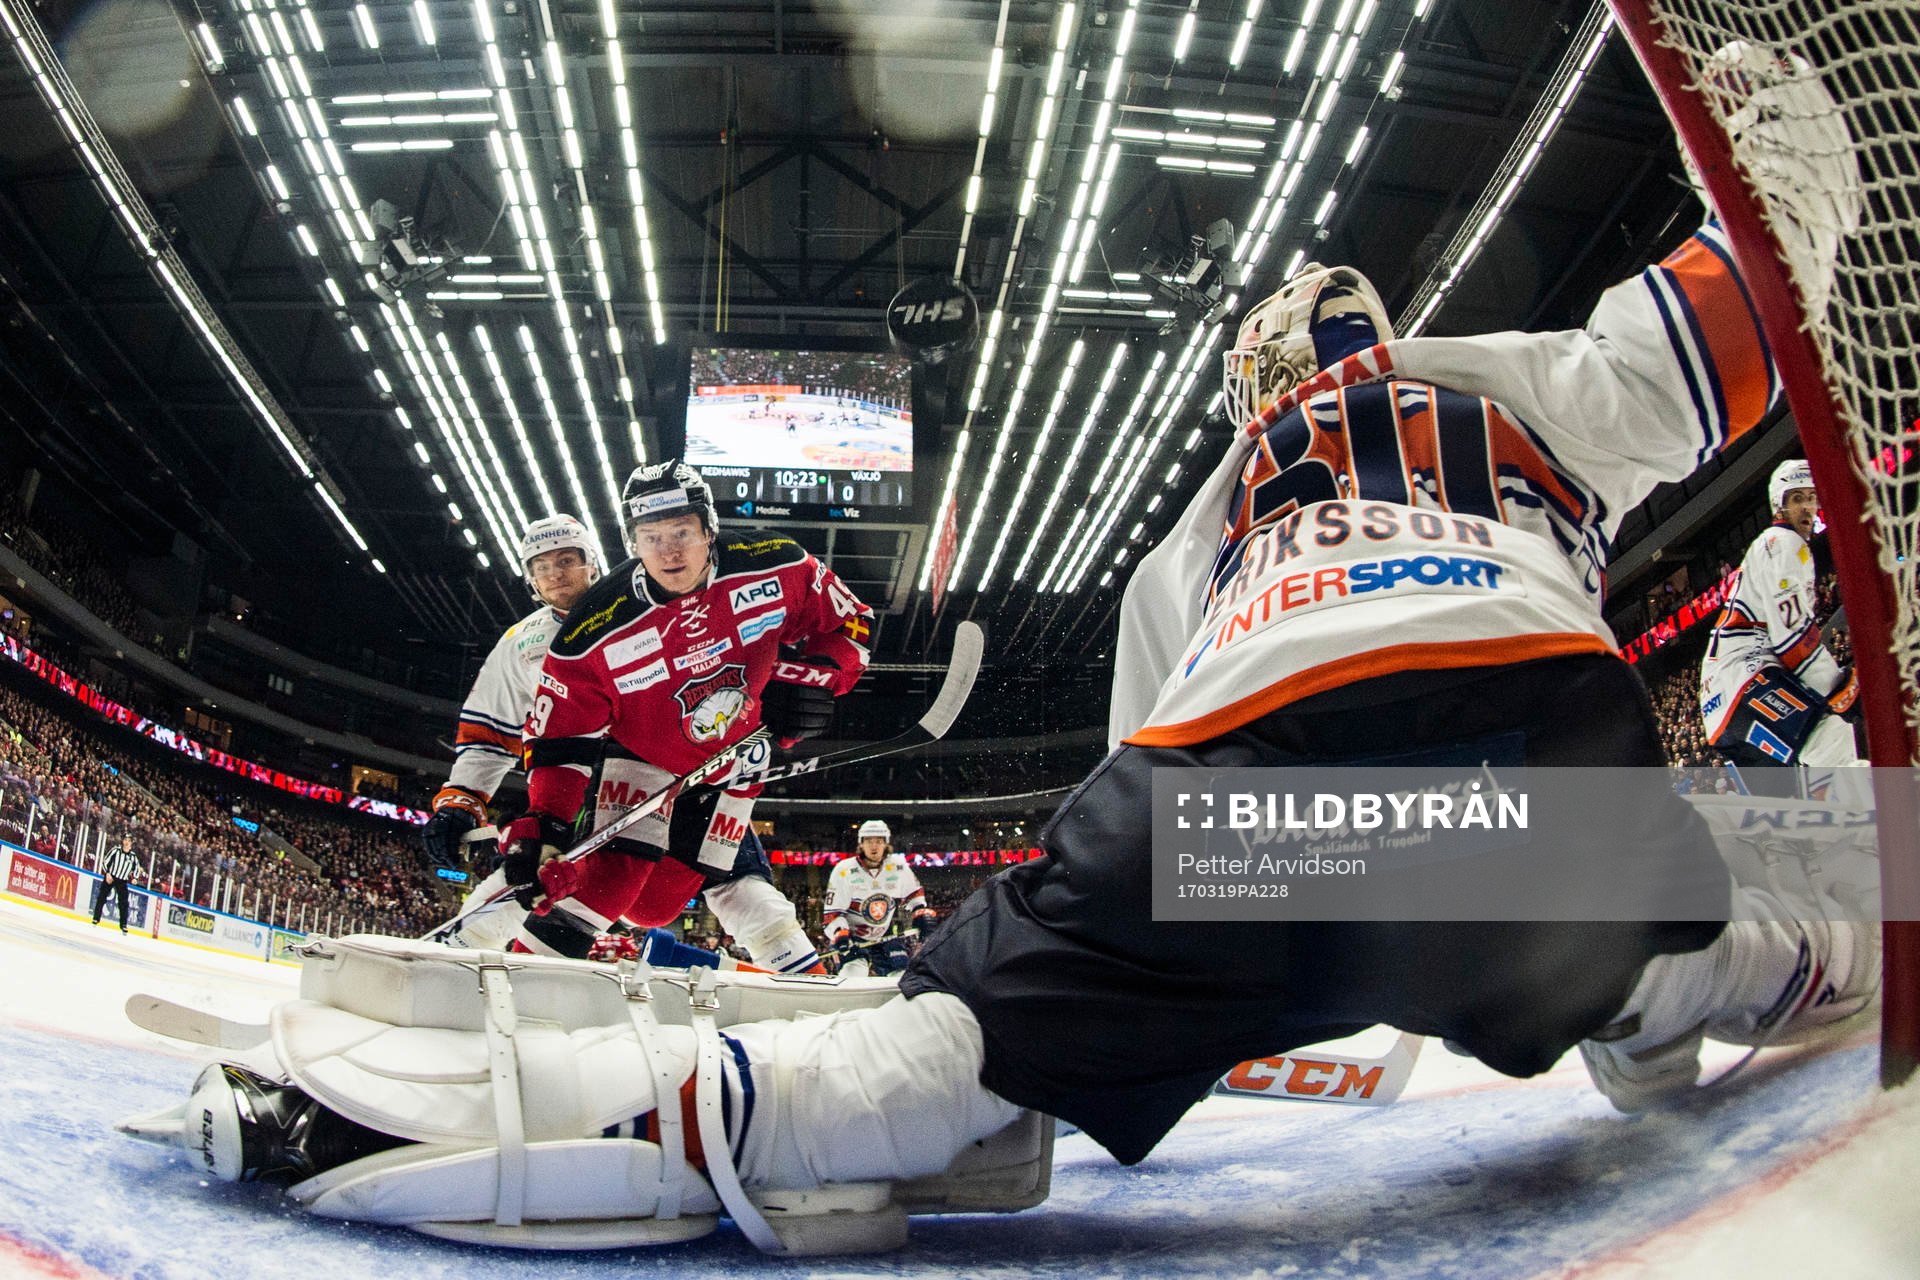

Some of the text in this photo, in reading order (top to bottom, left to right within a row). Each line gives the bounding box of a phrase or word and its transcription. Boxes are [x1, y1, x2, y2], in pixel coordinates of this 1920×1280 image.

[701, 466, 751, 478] REDHAWKS
[774, 470, 818, 487] 10:23
[736, 482, 748, 498] 0
[790, 488, 799, 503] 1
[842, 485, 854, 501] 0
[1205, 501, 1494, 631] ERIKSSON
[1216, 555, 1503, 651] INTERSPORT
[774, 661, 833, 686] CM
[688, 749, 737, 787] CCM
[1226, 1056, 1385, 1098] CCM
